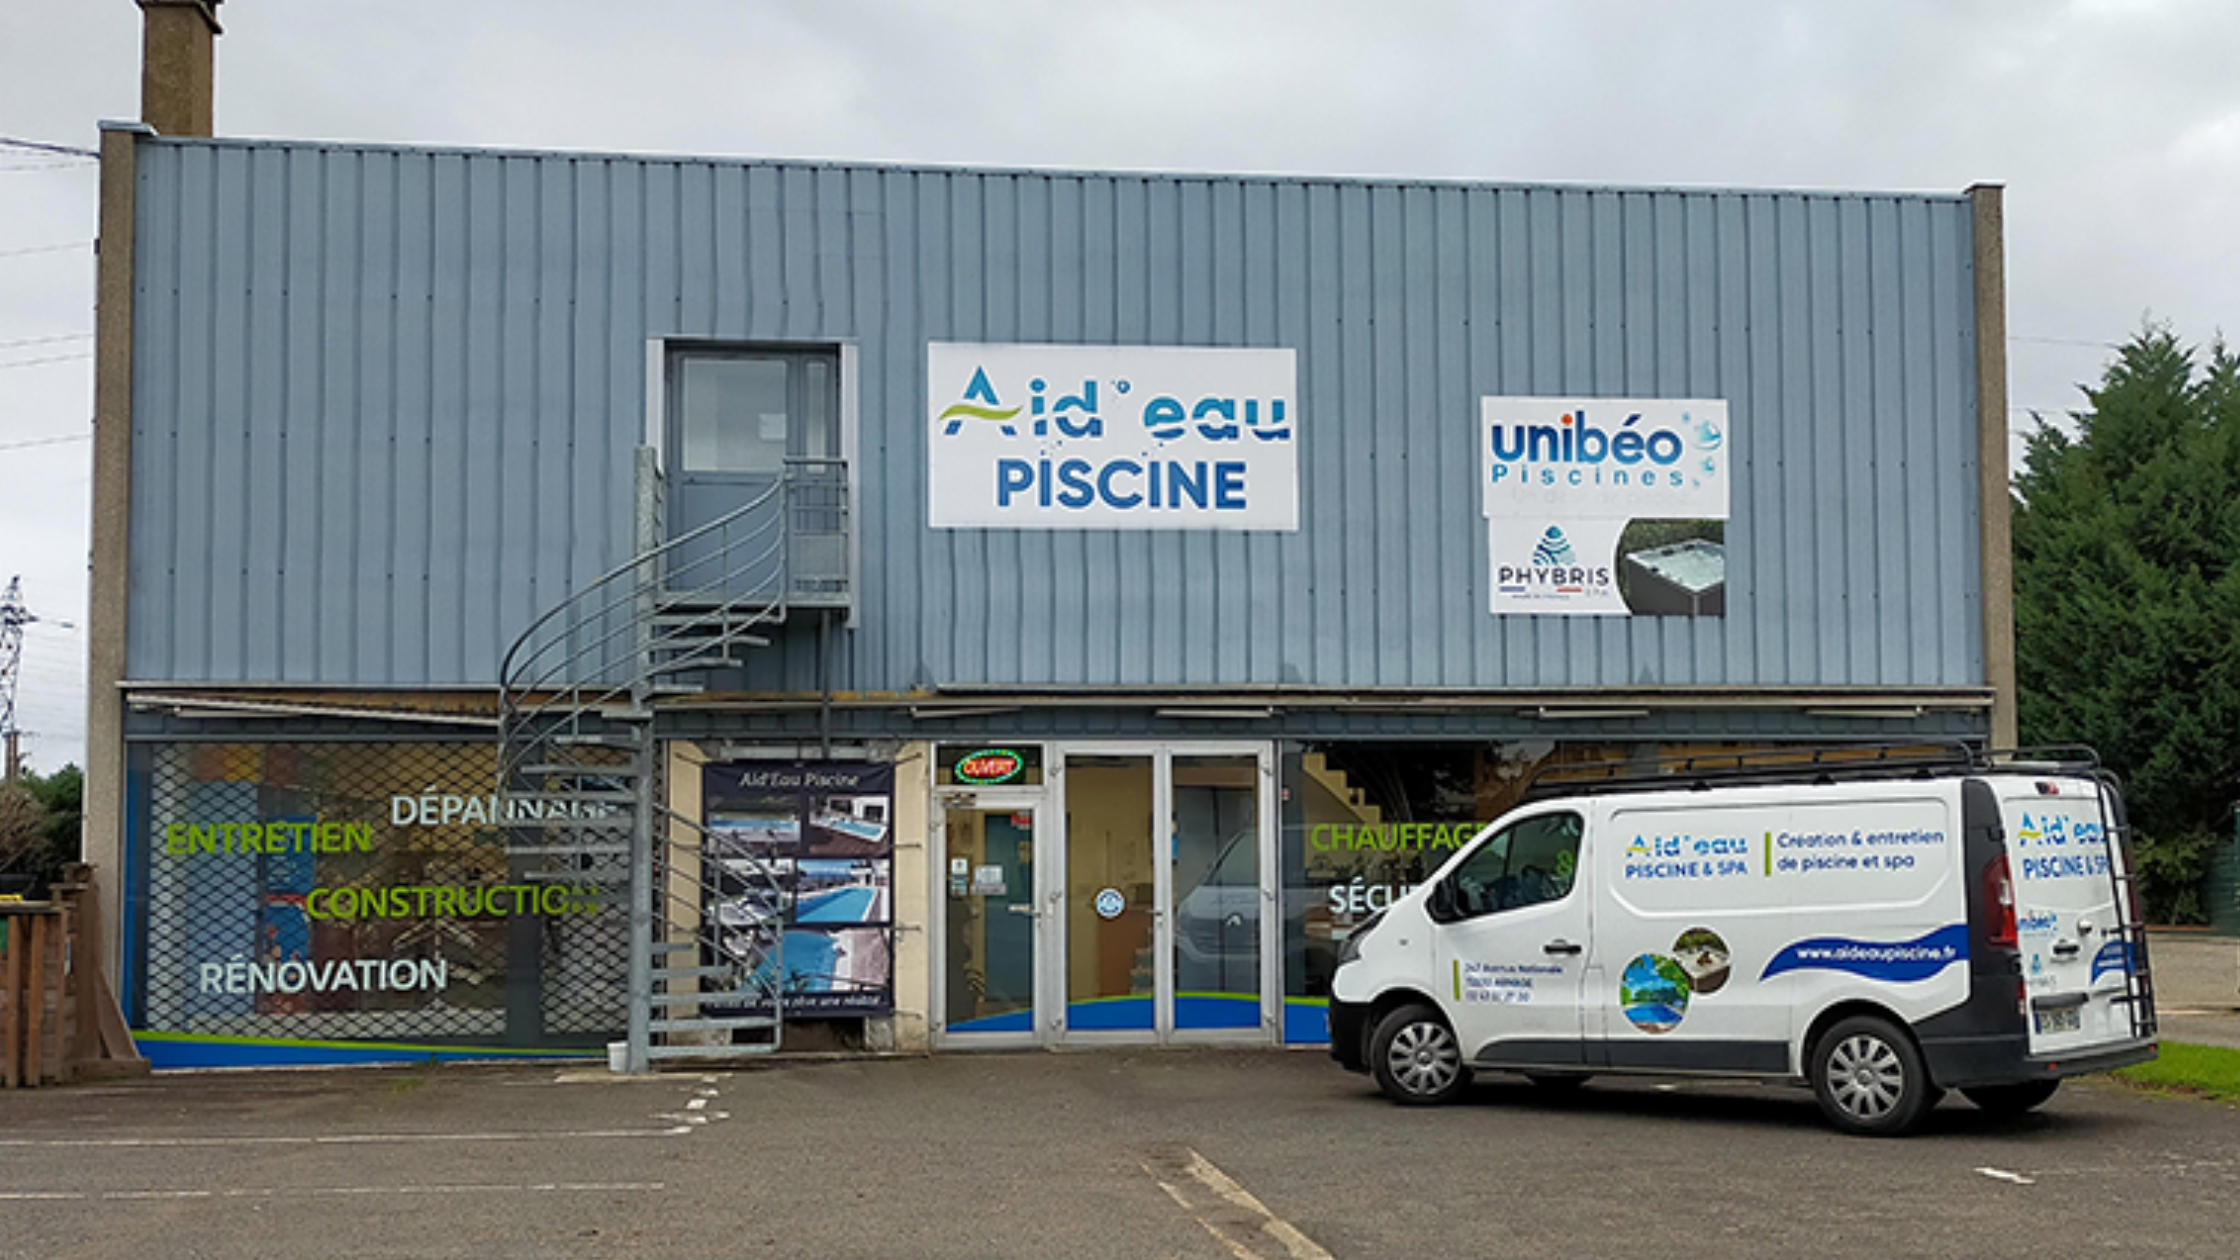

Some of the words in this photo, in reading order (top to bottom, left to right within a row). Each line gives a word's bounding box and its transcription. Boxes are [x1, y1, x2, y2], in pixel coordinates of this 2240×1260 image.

[1491, 410, 1683, 465] unibéo
[997, 458, 1247, 509] PISCINE
[1491, 464, 1683, 486] Piscines
[1499, 567, 1609, 585] PHYBRIS
[963, 757, 1015, 777] OUVERT
[165, 821, 373, 855] ENTRETIEN
[1310, 823, 1487, 851] CHAUFFAG
[1777, 832, 1847, 848] Création
[1866, 829, 1944, 845] entretien
[1625, 861, 1699, 878] PISCINE
[1717, 859, 1749, 876] SPA
[1777, 856, 1798, 871] de
[1801, 853, 1858, 872] piscine
[1862, 855, 1879, 868] et
[1884, 854, 1915, 870] spa
[2023, 856, 2084, 879] PISCINE
[1329, 876, 1419, 914] SÉCU
[199, 954, 448, 994] RÉNOVATION
